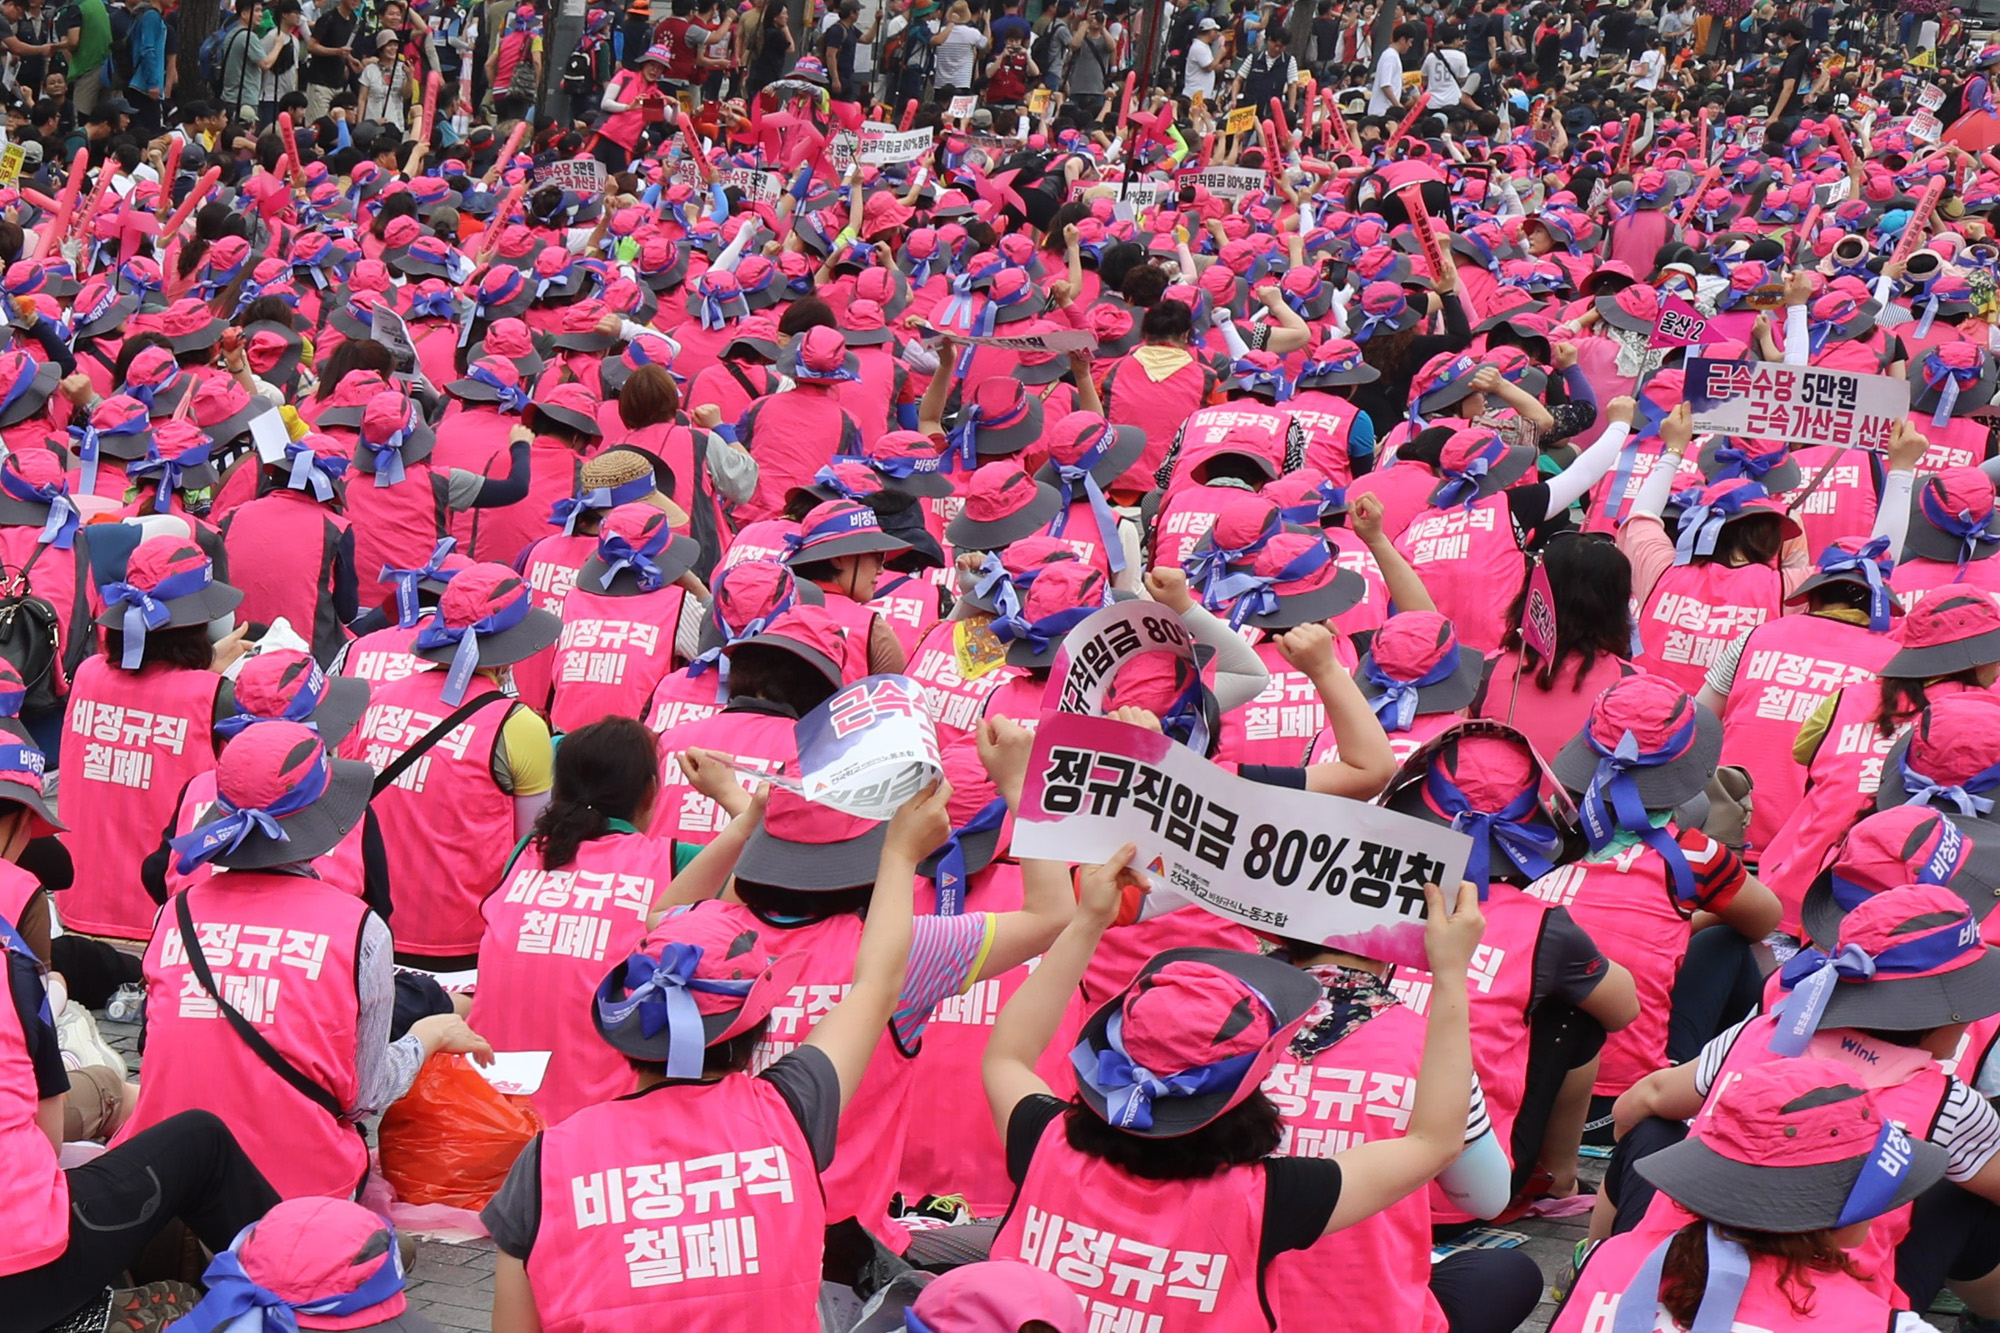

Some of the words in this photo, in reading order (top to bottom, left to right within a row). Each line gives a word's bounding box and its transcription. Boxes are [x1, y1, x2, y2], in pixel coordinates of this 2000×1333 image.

[1659, 310, 1691, 338] 울산
[1690, 320, 1705, 342] 2
[1707, 364, 1797, 402] 근속수당
[1801, 372, 1859, 410] 5만원
[1747, 401, 1854, 444] 근속가산금
[1404, 507, 1496, 547] 비정규직
[1412, 535, 1470, 566] 철폐!
[529, 561, 581, 596] 비정
[561, 652, 628, 686] 철폐!
[71, 697, 189, 756] 비정규직
[1244, 703, 1325, 742] 철폐!
[82, 742, 154, 791] 철폐!
[1040, 745, 1241, 871] 정규직임금
[504, 869, 655, 923] 비정규직
[160, 921, 331, 982] 비정규직
[515, 910, 613, 962] 철폐!
[571, 1145, 795, 1231] 비정규직
[622, 1215, 760, 1289] 철폐!
[1019, 1204, 1230, 1313] 비정규직
